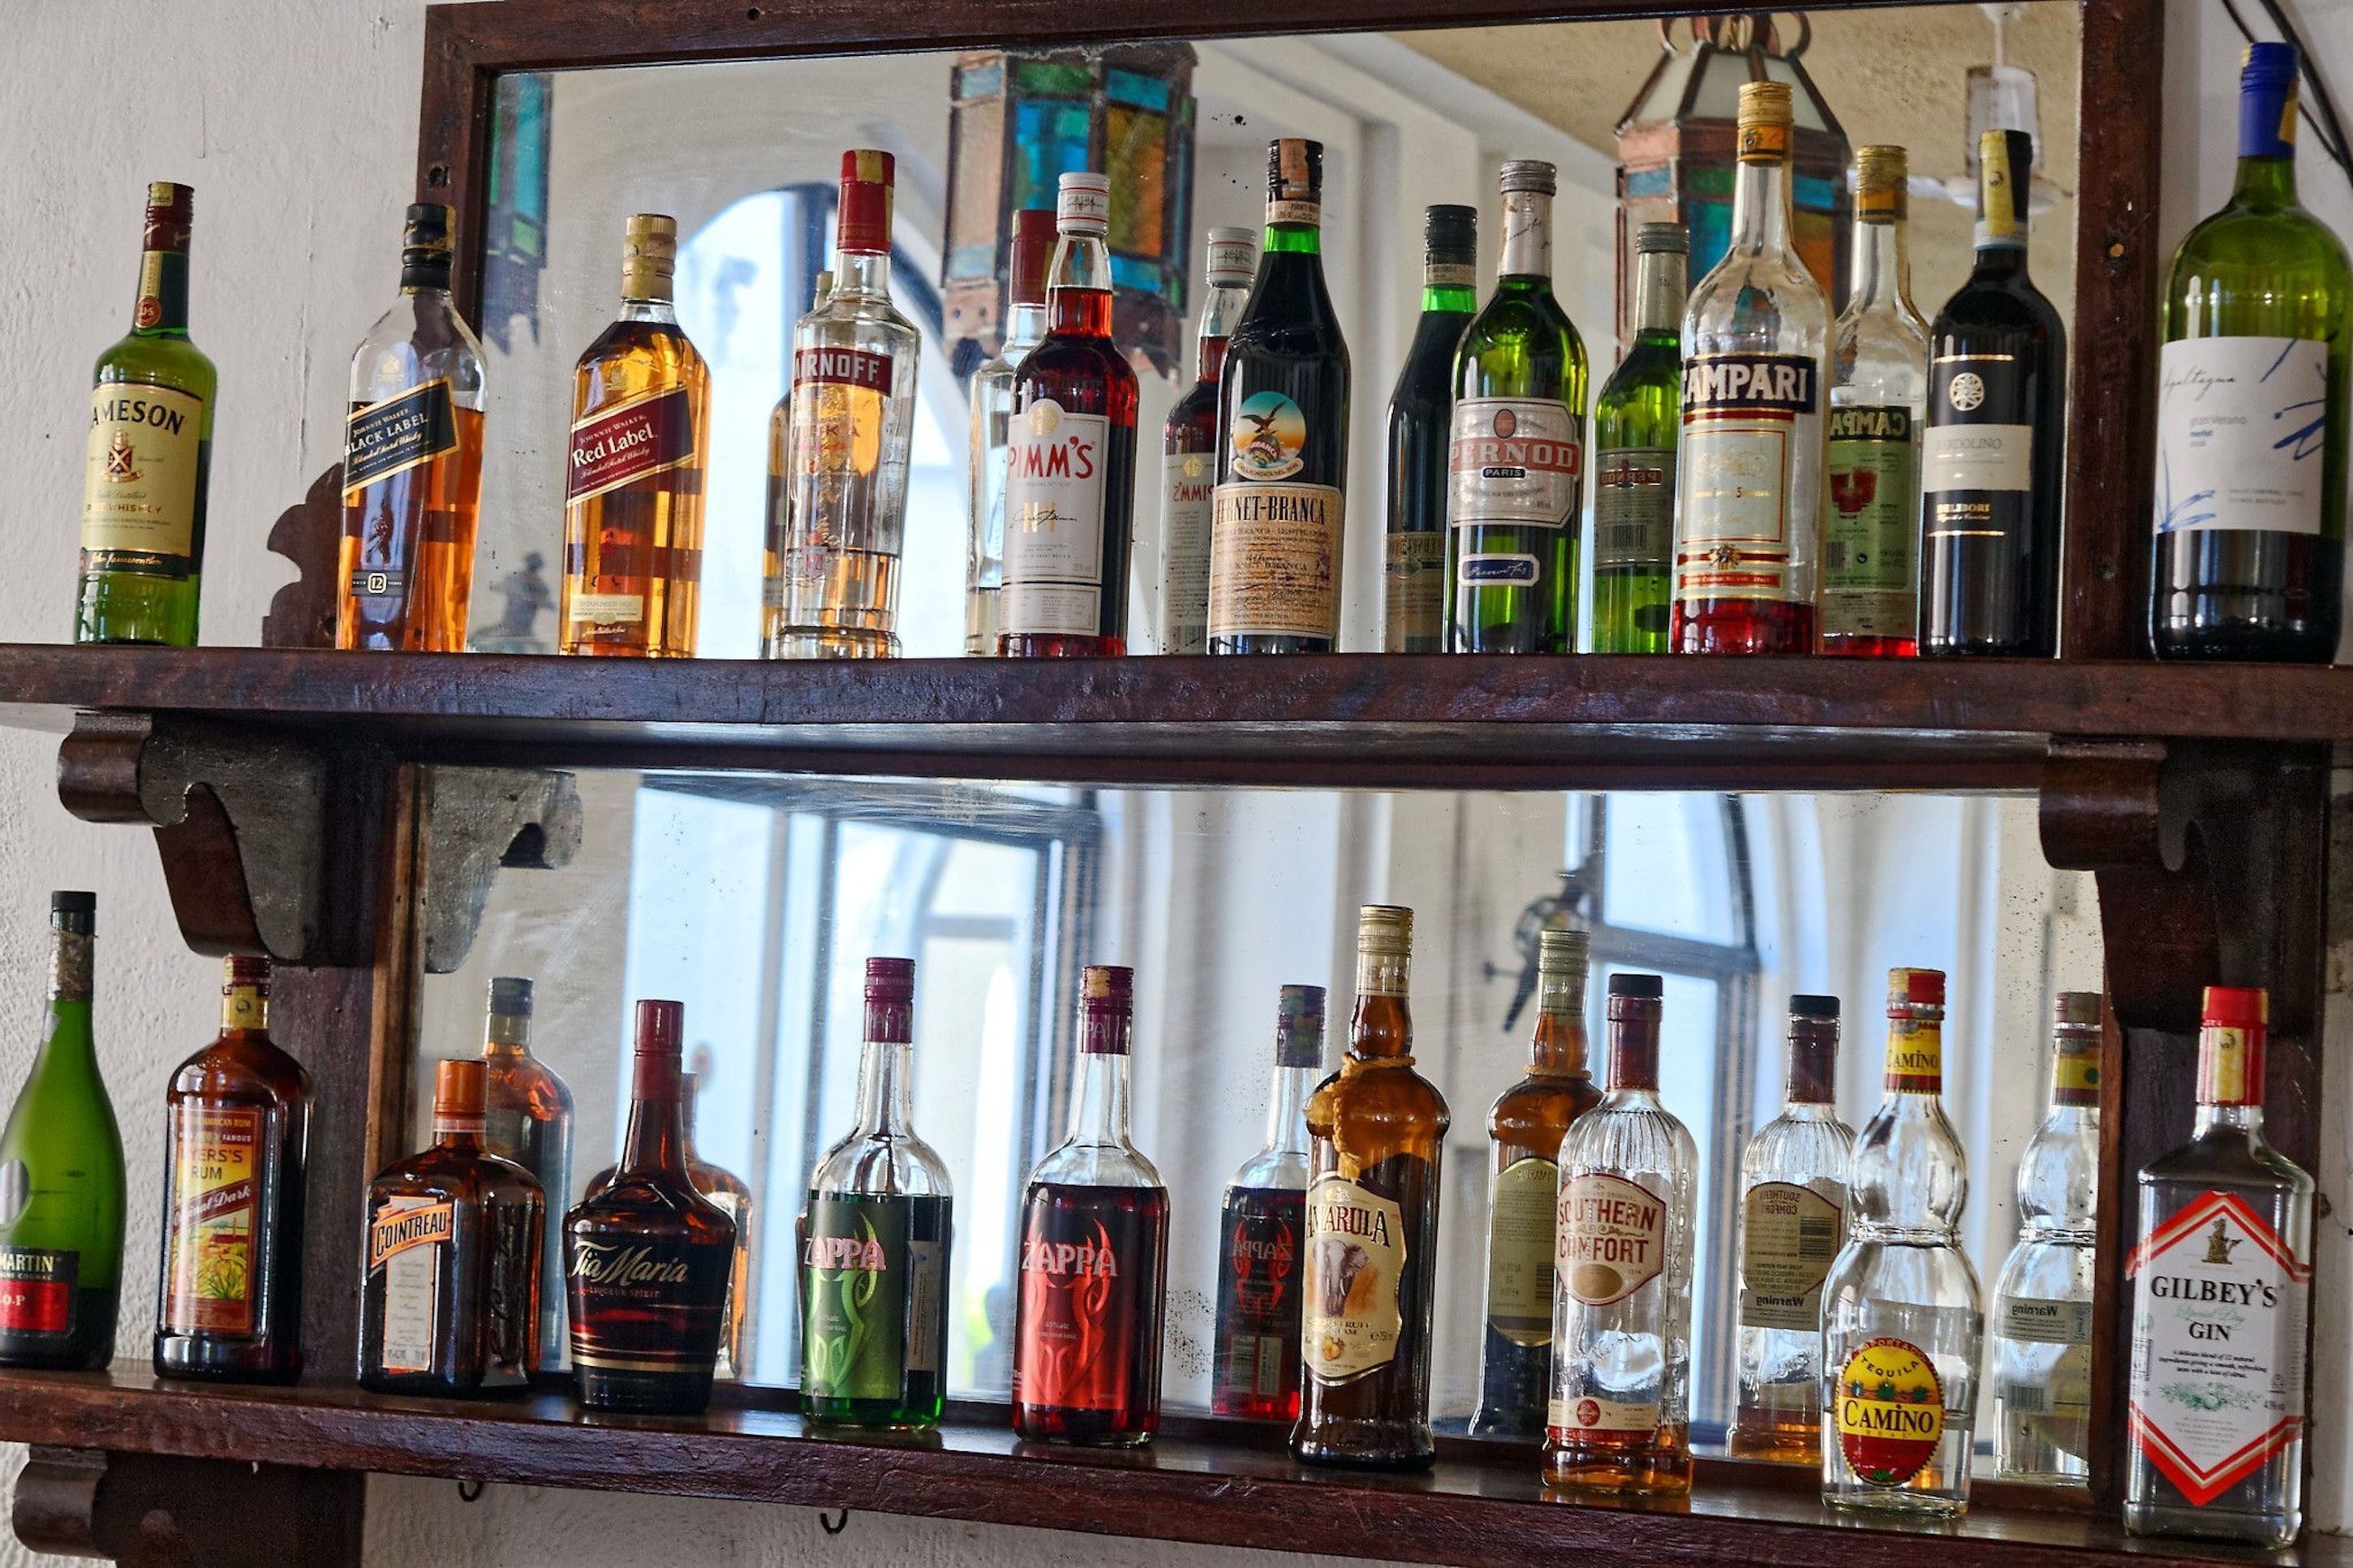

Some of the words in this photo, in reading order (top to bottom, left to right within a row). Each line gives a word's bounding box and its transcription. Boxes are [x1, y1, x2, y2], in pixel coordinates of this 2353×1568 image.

[1682, 363, 1809, 404] AMPARI
[91, 399, 185, 436] AMESON
[386, 412, 428, 438] LABEL
[571, 440, 607, 469] Red
[607, 422, 655, 455] Label
[1009, 436, 1094, 479] PIMM'S
[1452, 441, 1574, 468] PERNOD
[1485, 468, 1523, 477] PARIS
[1217, 496, 1325, 526] FERNET-BRANCA
[372, 577, 383, 590] 12
[1886, 1049, 1938, 1068] AMINO
[222, 1134, 252, 1142] FAMOUS
[191, 1166, 223, 1180] RUM
[214, 1184, 252, 1207] Dark
[1559, 1197, 1657, 1231] SOUTHERN
[376, 1211, 448, 1257] COINTREAU
[1559, 1234, 1650, 1263] COMFORT
[589, 1244, 690, 1287] Maria
[803, 1235, 888, 1272] ZAPPA
[1021, 1239, 1118, 1278] ZAPPA
[2150, 1275, 2278, 1308] GILBEY'S
[2188, 1321, 2231, 1342] GIN
[1861, 1355, 1921, 1378] TEQUILA
